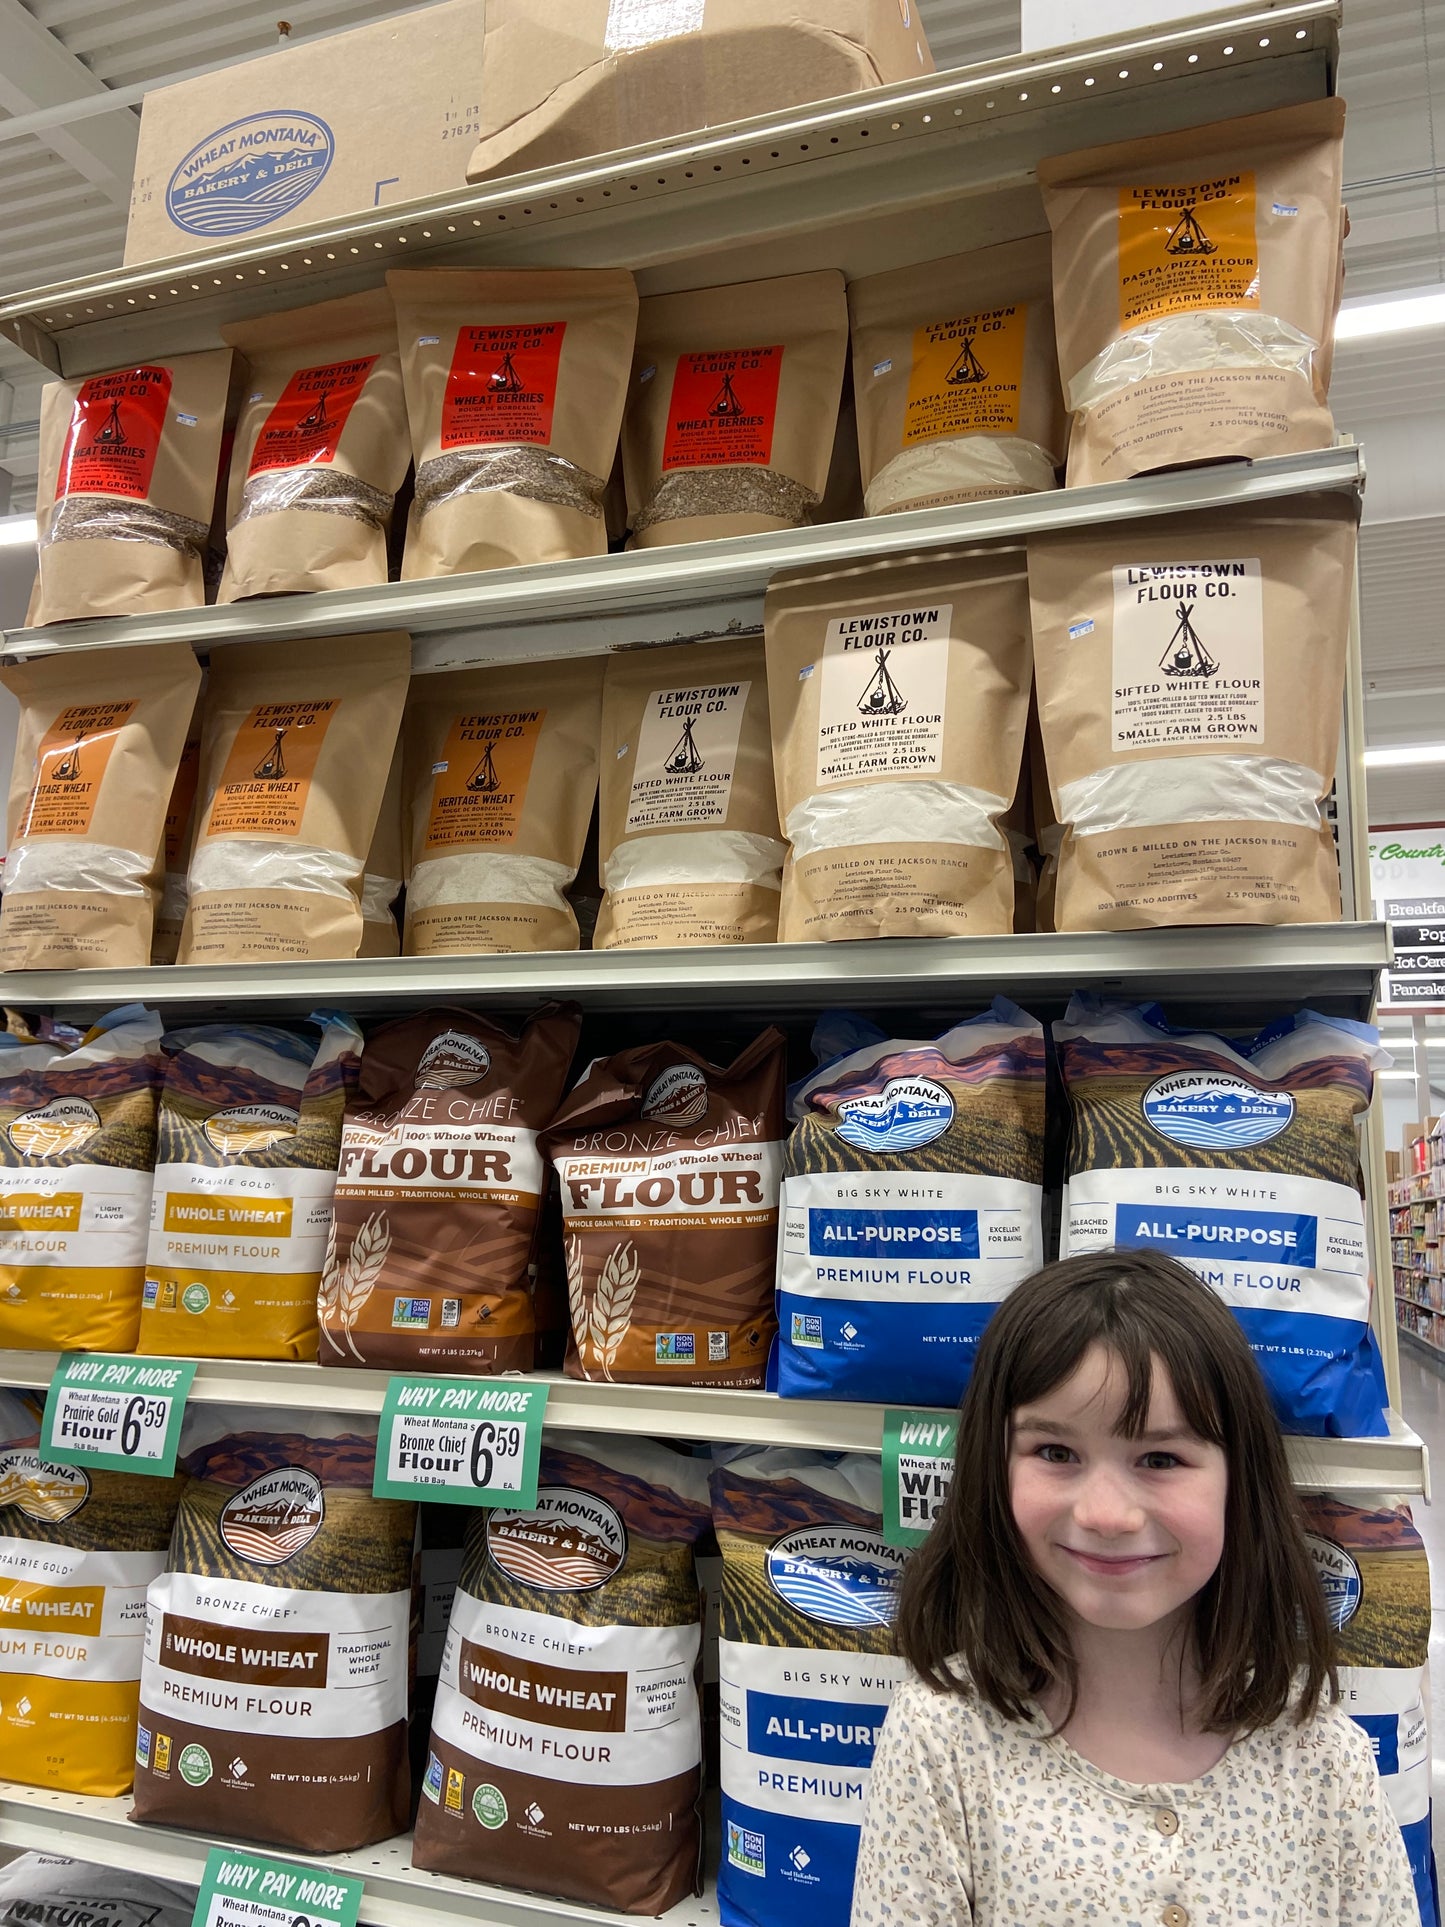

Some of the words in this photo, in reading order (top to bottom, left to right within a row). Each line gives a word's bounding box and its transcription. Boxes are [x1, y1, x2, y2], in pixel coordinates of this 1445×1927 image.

[239, 127, 316, 149] MONTANA
[184, 174, 251, 199] BAKERY
[274, 156, 313, 175] DELI
[1132, 176, 1240, 199] LEWISTOWN
[1140, 197, 1196, 211] FLOUR
[1212, 257, 1253, 267] FLOUR
[925, 306, 1017, 333] LEWISTOWN
[469, 326, 557, 340] LEWISTOWN
[473, 340, 518, 353] FLOUR
[688, 348, 774, 363] LEWISTOWN
[981, 384, 1018, 393] FLOUR
[496, 392, 545, 404] BERRIES
[973, 415, 1014, 424] GROWN
[508, 428, 547, 438] GROWN
[729, 450, 767, 458] GROWN
[1127, 563, 1246, 586] LEWISTOWN
[1136, 584, 1198, 605] FLOUR
[1205, 582, 1237, 599] CO.
[838, 610, 939, 635] LEWISTOWN
[843, 631, 896, 651] FLOUR
[901, 629, 928, 644] CO.
[657, 685, 740, 705] LEWISTOWN
[1114, 683, 1161, 699] SIFTED
[1165, 679, 1210, 692] WHITE
[1214, 678, 1261, 690] FLOUR
[63, 702, 133, 720] LEWISTOWN
[256, 701, 333, 717] LEWISTOWN
[659, 703, 703, 719] FLOUR
[59, 717, 95, 732] FLOUR
[253, 715, 296, 730] FLOUR
[460, 711, 540, 728] LEWISTOWN
[820, 722, 858, 737] SIFTED
[861, 718, 898, 730] WHITE
[901, 714, 942, 727] FLOUR
[1207, 713, 1225, 723] 2.5
[1227, 713, 1247, 722] LBS
[460, 727, 501, 741] FLOUR
[1117, 728, 1161, 742] SMALL
[1166, 724, 1202, 736] FARM
[1207, 723, 1259, 735] GROWN
[820, 762, 855, 777] SMALL
[858, 757, 889, 770] FARM
[891, 754, 936, 766] GROWN
[632, 778, 663, 792] SIFTED
[698, 773, 732, 783] FLOUR
[236, 816, 259, 826] FARM
[658, 810, 684, 820] FARM
[686, 807, 724, 817] GROWN
[454, 829, 477, 838] FARM
[479, 828, 514, 838] GROWN
[897, 857, 938, 866] JACKSON
[1154, 1077, 1205, 1098] WHEAT
[447, 1097, 520, 1122] CHIEF
[908, 1109, 941, 1119] DELI
[1156, 1104, 1220, 1115] BAKERY
[1240, 1104, 1278, 1116] DELI
[433, 1131, 472, 1142] Whole
[474, 1132, 517, 1144] Wheat
[573, 1132, 683, 1152] BRONZE
[693, 1114, 762, 1148] CHIEF
[338, 1146, 514, 1184] FLOUR
[568, 1160, 648, 1178] PREMIUM
[678, 1153, 720, 1166] Whole
[721, 1150, 763, 1163] Wheat
[191, 1177, 235, 1187] PRAIRIE
[240, 1180, 273, 1190] GOLD
[566, 1169, 765, 1211] FLOUR
[367, 1189, 395, 1198] MILLED
[400, 1190, 457, 1200] TRADITIONAL
[458, 1191, 488, 1201] WHOLE
[837, 1188, 859, 1199] BIG
[864, 1188, 892, 1198] SKY
[898, 1188, 944, 1199] WHITE
[1154, 1184, 1182, 1196] BIG
[1188, 1185, 1218, 1197] SKY
[1225, 1187, 1279, 1201] WHITE
[20, 1205, 75, 1219] WHEAT
[176, 1208, 227, 1222] WHOLE
[229, 1209, 286, 1225] WHEAT
[568, 1219, 594, 1229] WHOLE
[594, 1219, 614, 1228] GRAIN
[614, 1219, 642, 1228] MILLED
[648, 1217, 708, 1228] TRADITIONAL
[709, 1216, 743, 1226] WHOLE
[989, 1226, 1021, 1234] EXCELLENT
[823, 1225, 963, 1243] ALL-PURPOSE
[1135, 1220, 1298, 1248] ALL-PURPOSE
[167, 1241, 229, 1256] PREMIUM
[233, 1244, 281, 1259] FLOUR
[1326, 1246, 1342, 1255] FOR
[816, 1267, 900, 1285] PREMIUM
[907, 1270, 972, 1285] FLOUR
[1234, 1273, 1302, 1293] FLOUR
[64, 1360, 100, 1384] WHY
[102, 1363, 132, 1387] PAY
[133, 1365, 183, 1390] MORE
[397, 1385, 438, 1409] WHY
[440, 1387, 478, 1411] PAY
[477, 1389, 533, 1414] MORE
[62, 1403, 96, 1422] Prairie
[60, 1420, 118, 1443] Flour
[403, 1416, 430, 1428] Wheat
[431, 1418, 468, 1432] Montana
[899, 1421, 951, 1447] WHY
[398, 1434, 435, 1453] Bronze
[438, 1435, 467, 1456] Chief
[397, 1452, 466, 1473] Flour
[899, 1457, 938, 1471] Wheat
[233, 1512, 283, 1526] BAKERY
[497, 1525, 556, 1546] BAKERY
[783, 1538, 837, 1554] WHEAT
[783, 1564, 854, 1582] BAKERY
[25, 1599, 95, 1619] WHEAT
[196, 1596, 246, 1613] BRONZE
[336, 1640, 393, 1655] TRADITIONAL
[486, 1624, 536, 1644] BRONZE
[543, 1638, 585, 1655] CHIEF
[33, 1641, 89, 1662] FLOUR
[173, 1634, 237, 1664] WHOLE
[240, 1648, 320, 1670] WHEAT
[349, 1653, 382, 1665] WHOLE
[349, 1663, 381, 1676] WHEAT
[635, 1676, 687, 1694] TRADITIONAL
[784, 1671, 811, 1682] BIG
[820, 1673, 850, 1686] SKY
[470, 1663, 531, 1701] WHOLE
[535, 1684, 617, 1713] WHEAT
[163, 1680, 239, 1712] PREMIUM
[246, 1698, 313, 1717] FLOUR
[646, 1690, 678, 1704] WHOLE
[647, 1702, 676, 1716] WHEAT
[462, 1711, 533, 1753] PREMIUM
[541, 1740, 612, 1763] FLOUR
[270, 1773, 287, 1781] NET
[758, 1770, 864, 1801] PREMIUM
[568, 1822, 586, 1832] NET
[613, 1825, 631, 1834] LBS
[216, 1861, 260, 1889] WHY
[259, 1871, 297, 1898] PAY
[297, 1879, 349, 1911] MORE
